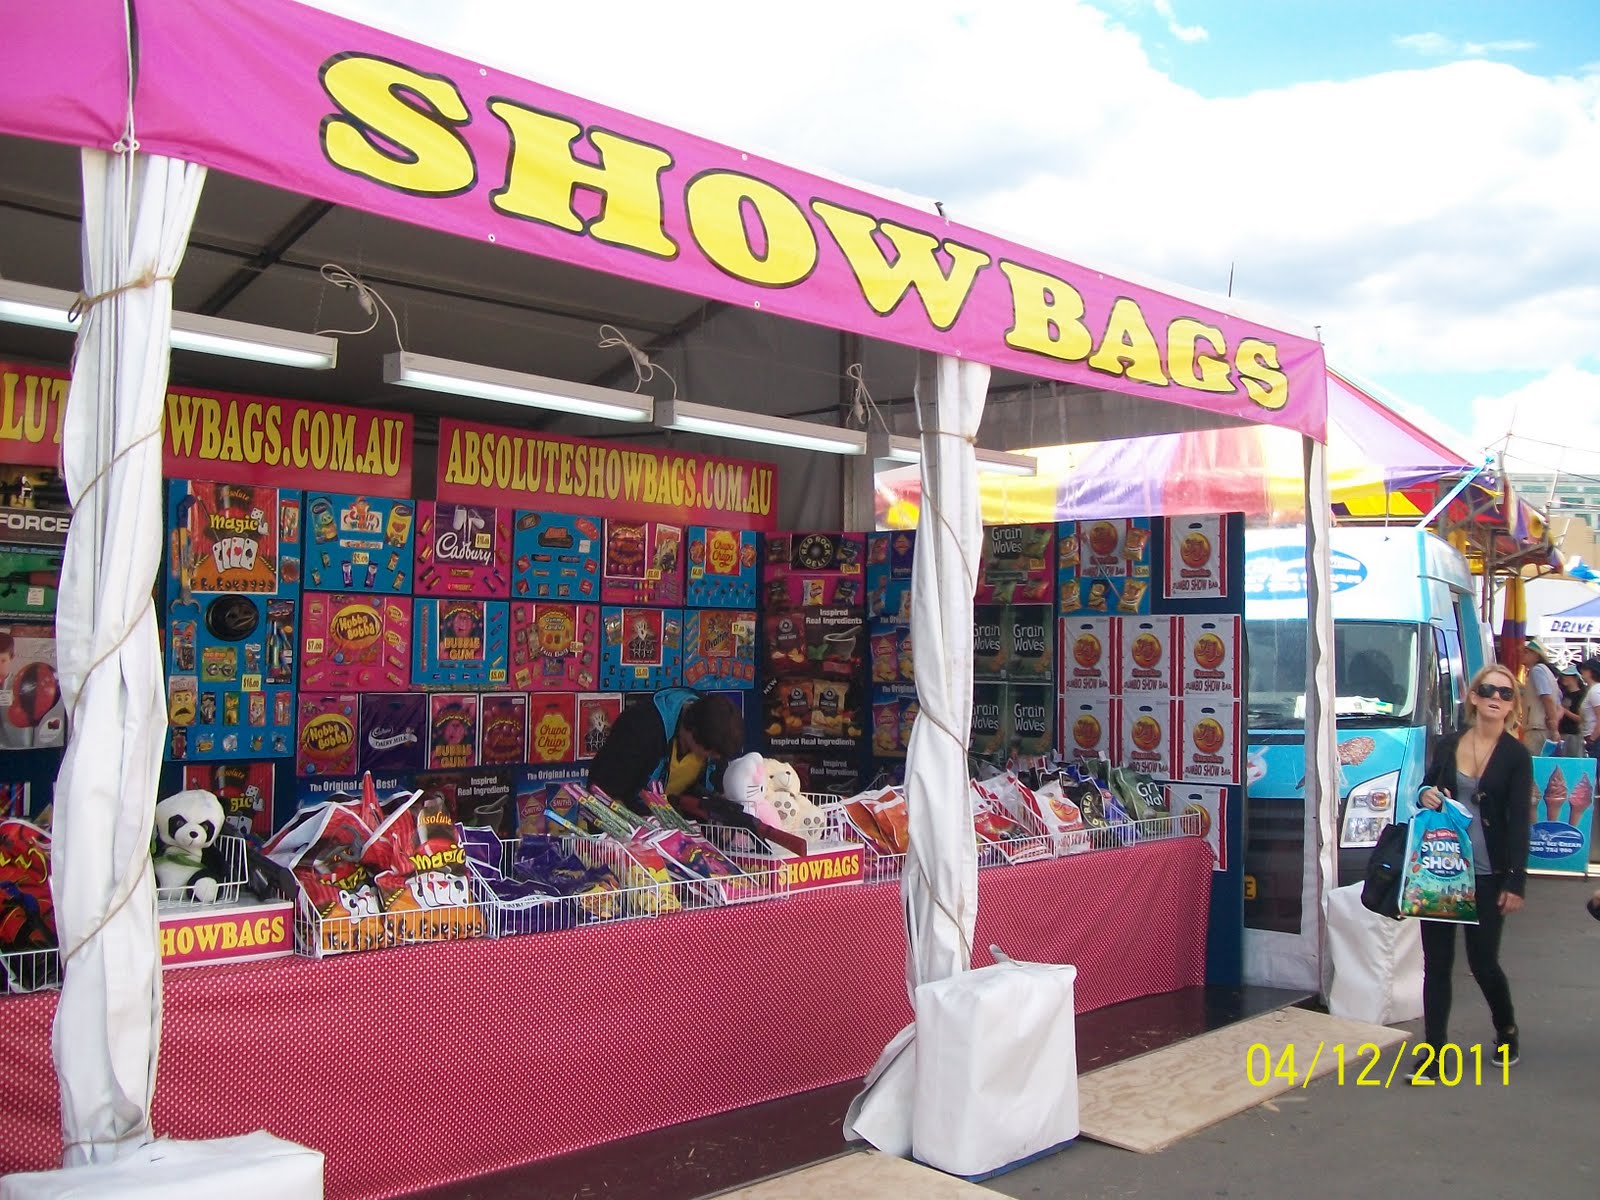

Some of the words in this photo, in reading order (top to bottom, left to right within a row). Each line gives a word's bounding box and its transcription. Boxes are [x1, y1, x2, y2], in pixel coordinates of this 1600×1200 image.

[319, 51, 1290, 411] SHOWBAGS
[161, 393, 404, 477] WBAGS.COM.AU
[445, 428, 773, 516] ABSOLUTESHOWBAGS.COM.AU
[991, 526, 1023, 541] Grain
[435, 532, 492, 566] Cadbury
[992, 541, 1023, 554] Waves
[819, 608, 849, 616] Inspired
[805, 617, 822, 625] Real
[823, 617, 863, 626] Ingredients
[1012, 623, 1045, 637] Grain
[1013, 640, 1045, 652] Waves
[449, 648, 476, 660] GUM
[763, 678, 778, 696] NEW
[891, 684, 915, 694] Original
[1083, 678, 1098, 690] SHOW
[1142, 678, 1157, 691] SHOW
[1204, 680, 1221, 692] SHOW
[1013, 703, 1046, 718] Grain
[540, 724, 568, 737] Chupa
[1014, 718, 1046, 732] Waves
[537, 736, 566, 748] Chups
[771, 738, 800, 746] Inspired
[817, 738, 856, 746] Ingredients
[440, 755, 467, 766] GUM
[822, 759, 848, 768] Inspired
[1142, 762, 1157, 773] SHOW
[1203, 765, 1220, 777] SHOW
[538, 769, 566, 781] Original
[310, 783, 323, 792] The
[323, 780, 358, 792] Original
[376, 779, 397, 789] Best!
[470, 776, 498, 787] Inspired
[457, 787, 472, 796] Real
[473, 784, 510, 796] Ingredients
[778, 854, 859, 885] SHOWBAGS
[1421, 856, 1467, 871] SHOW
